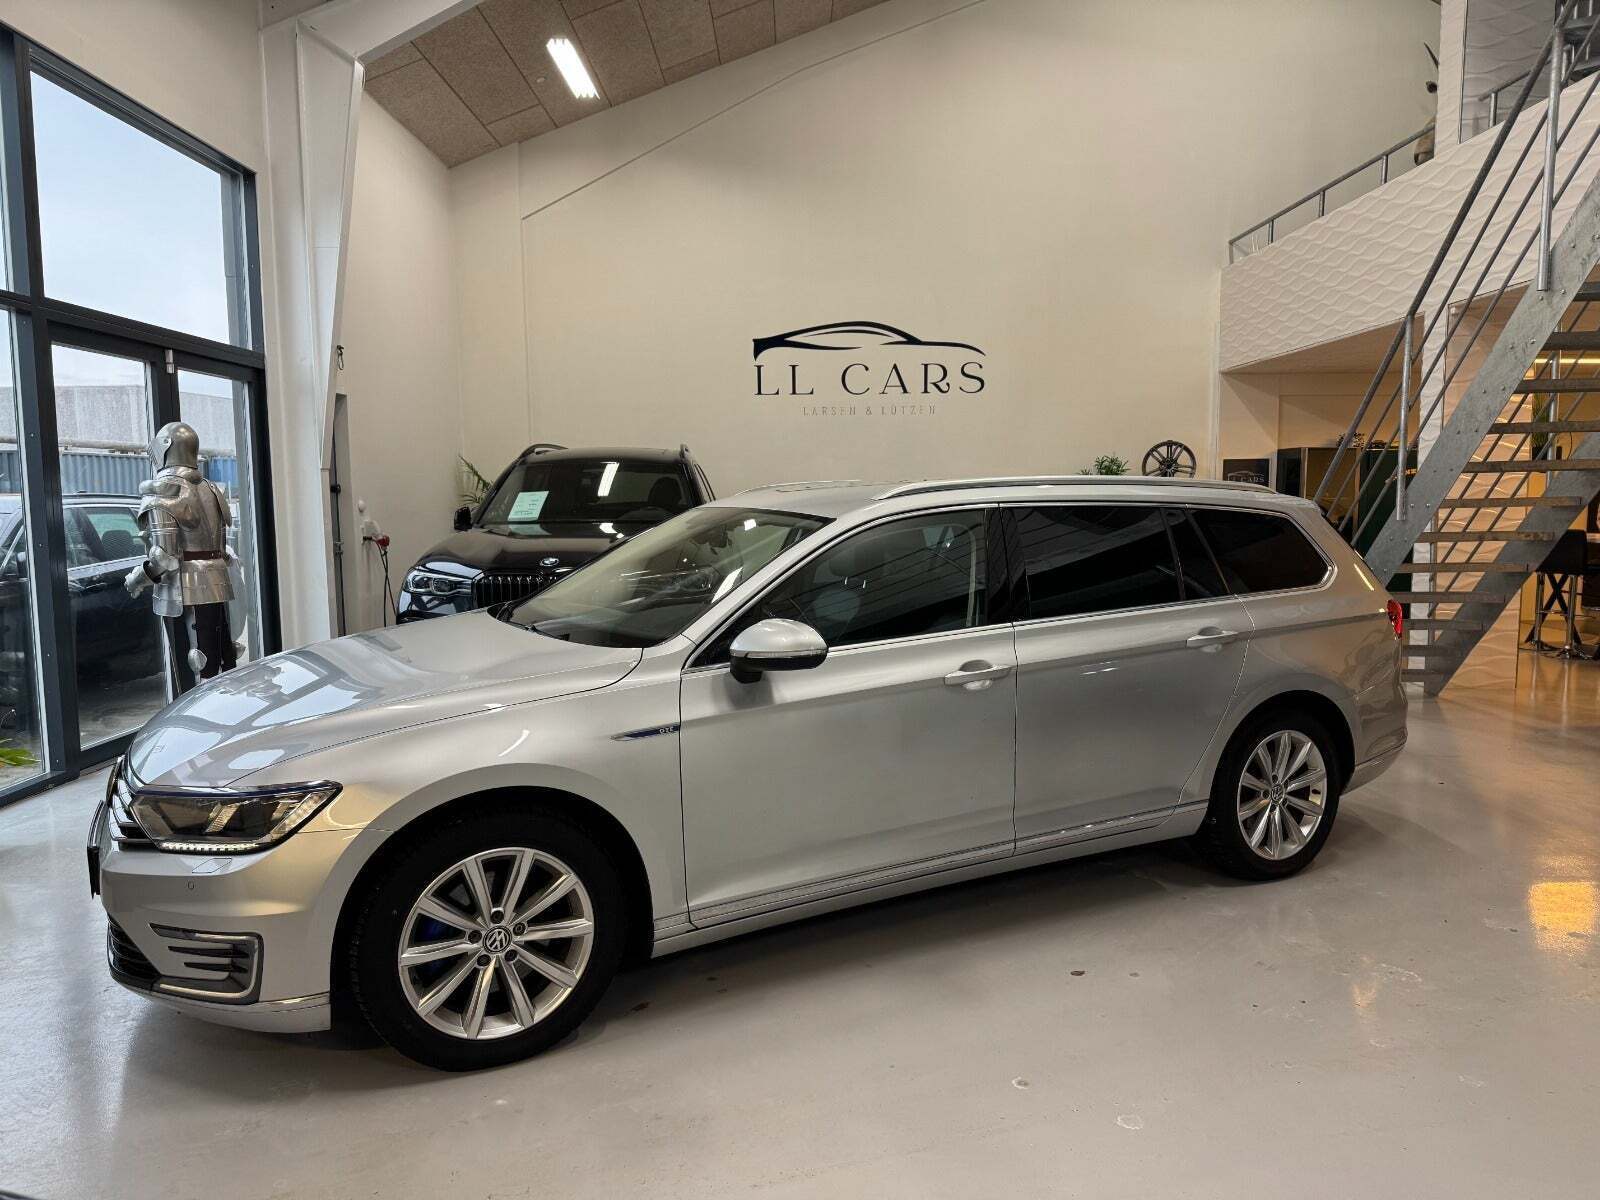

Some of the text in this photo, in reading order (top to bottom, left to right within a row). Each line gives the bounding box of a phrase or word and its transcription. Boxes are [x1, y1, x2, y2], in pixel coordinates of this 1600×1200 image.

[754, 361, 985, 395] LL CARS
[802, 405, 857, 417] LARSEN
[865, 405, 873, 417] &
